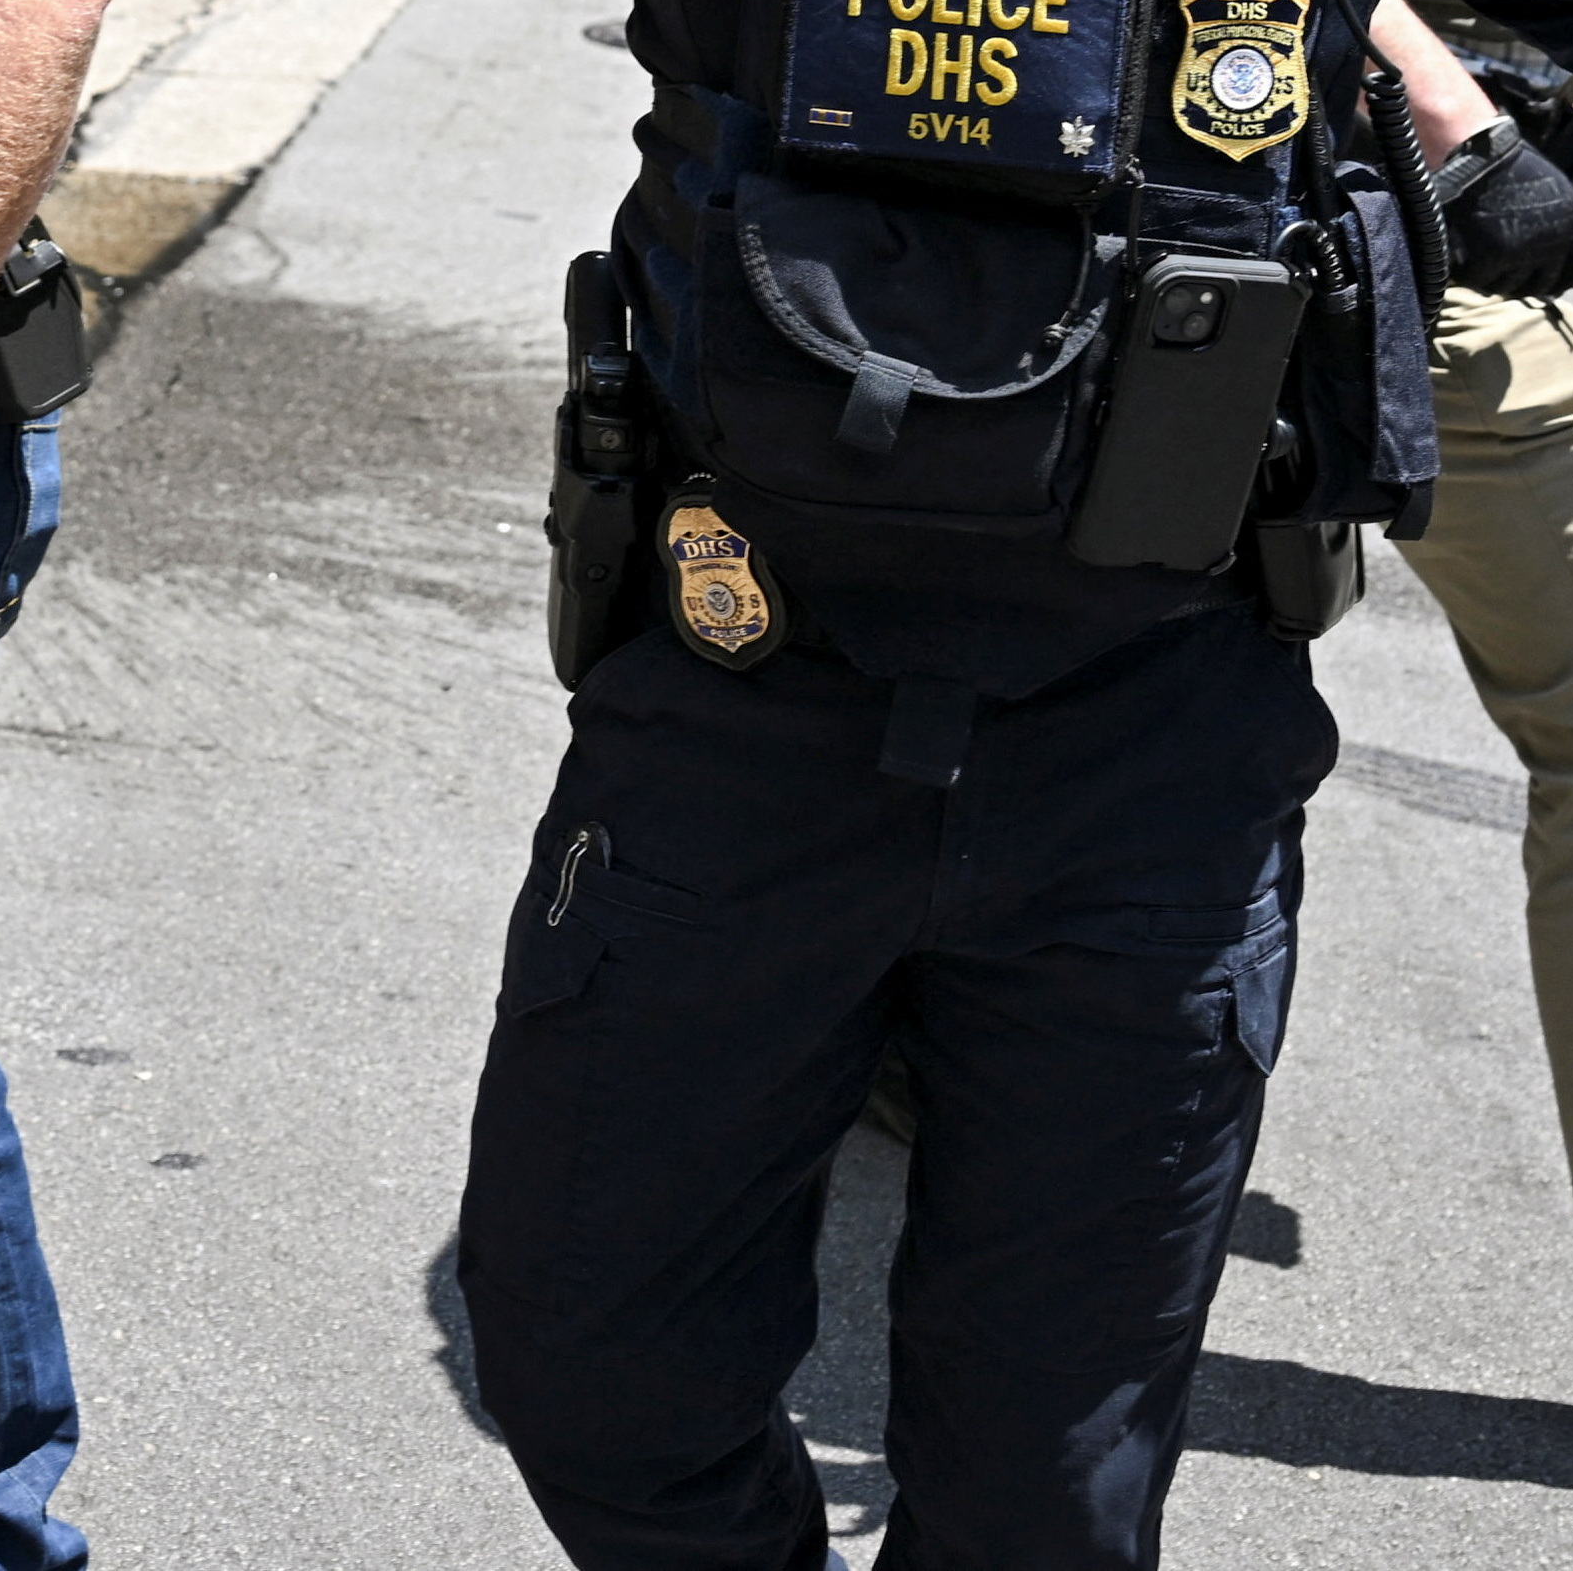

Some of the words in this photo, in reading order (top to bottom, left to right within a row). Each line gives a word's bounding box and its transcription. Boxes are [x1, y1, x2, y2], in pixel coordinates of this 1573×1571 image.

[1226, 1, 1269, 20] DHS
[885, 28, 1019, 106] DHS
[908, 112, 992, 146] 5V14
[1210, 121, 1266, 136] POLICE
[682, 540, 735, 559] DHS
[710, 627, 747, 638] POLICE
